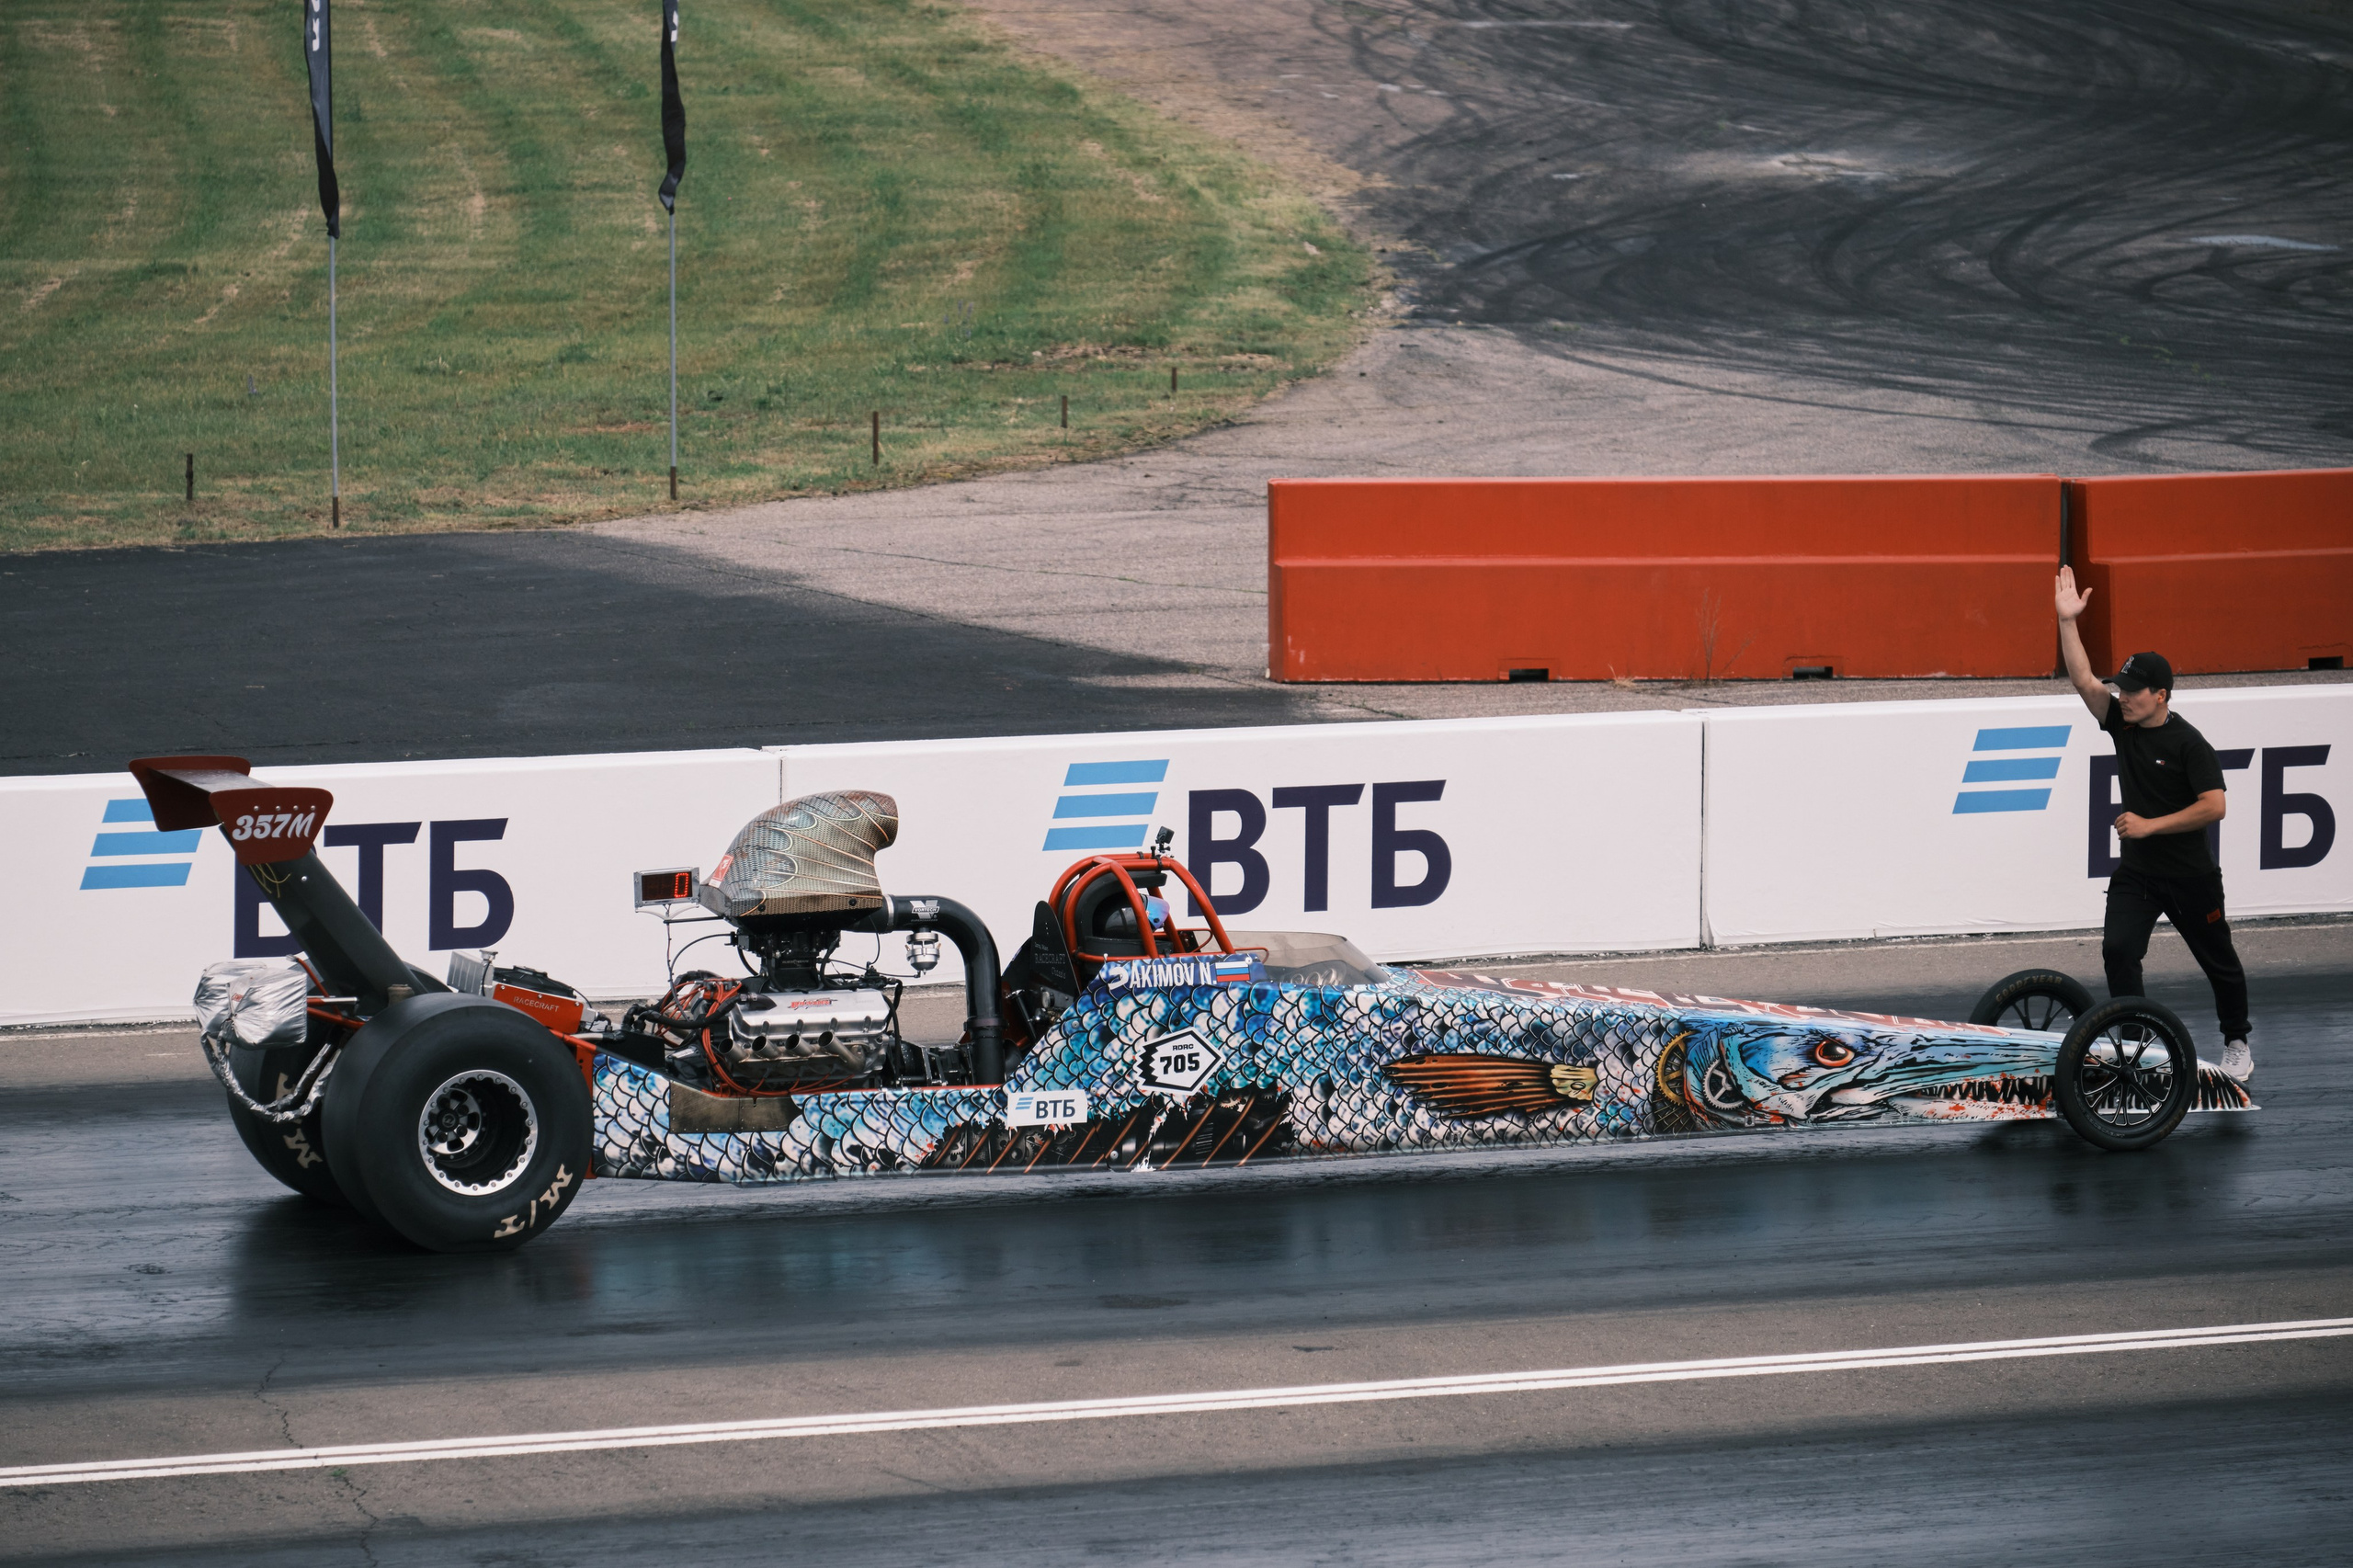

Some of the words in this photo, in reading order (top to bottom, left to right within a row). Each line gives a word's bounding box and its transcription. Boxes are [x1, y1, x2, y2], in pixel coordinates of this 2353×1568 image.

[232, 812, 316, 841] 357M
[1187, 778, 1452, 917] ВТБ
[674, 872, 689, 898] 0
[1199, 961, 1217, 985] N.
[513, 995, 560, 1013] RACECRAFT
[1172, 1043, 1194, 1051] RDRC
[1159, 1051, 1200, 1075] 705
[1035, 1097, 1076, 1120] ВТБ
[494, 1163, 574, 1239] M/T
